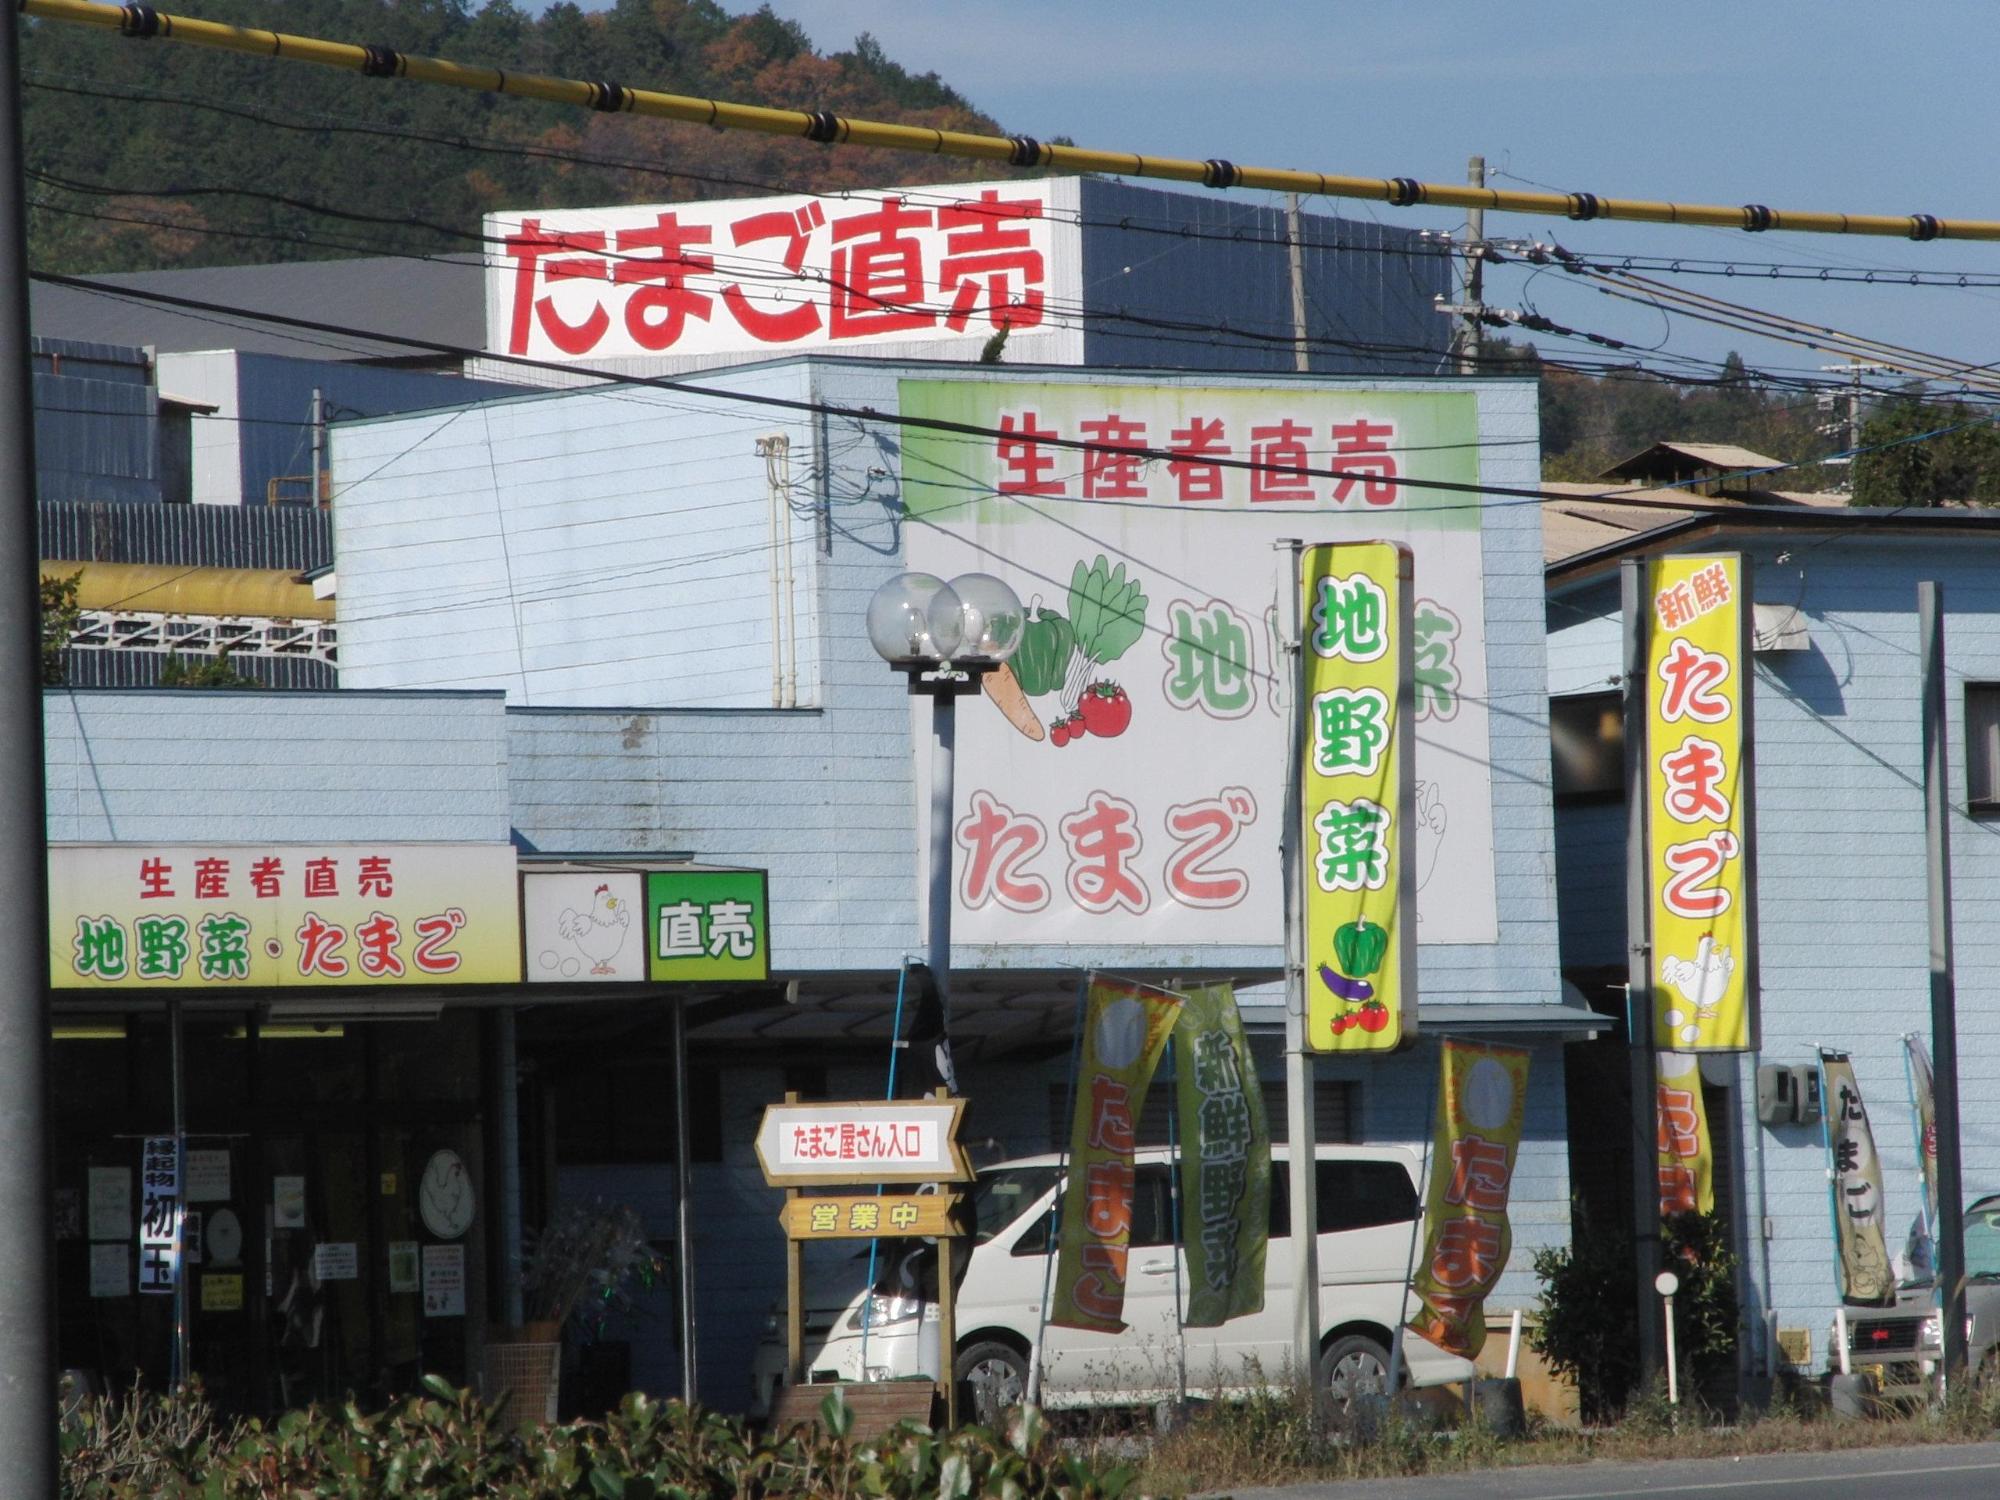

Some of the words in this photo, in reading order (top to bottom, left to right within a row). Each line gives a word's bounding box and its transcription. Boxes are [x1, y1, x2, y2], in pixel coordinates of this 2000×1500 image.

[505, 189, 1044, 355] たまご直売
[996, 411, 1397, 506] 生産者直売
[1656, 562, 1731, 630] 新鮮
[1315, 575, 1387, 887] 地野菜
[1660, 639, 1737, 917] たまご
[139, 855, 394, 900] 生産者直売
[960, 789, 1255, 911] たまご
[658, 898, 755, 959] 直売
[793, 1123, 921, 1159] たまご屋さん入口
[1193, 1030, 1252, 1291] 新鮮野菜
[1837, 1084, 1872, 1219] たまご
[810, 1202, 919, 1232] 営業中
